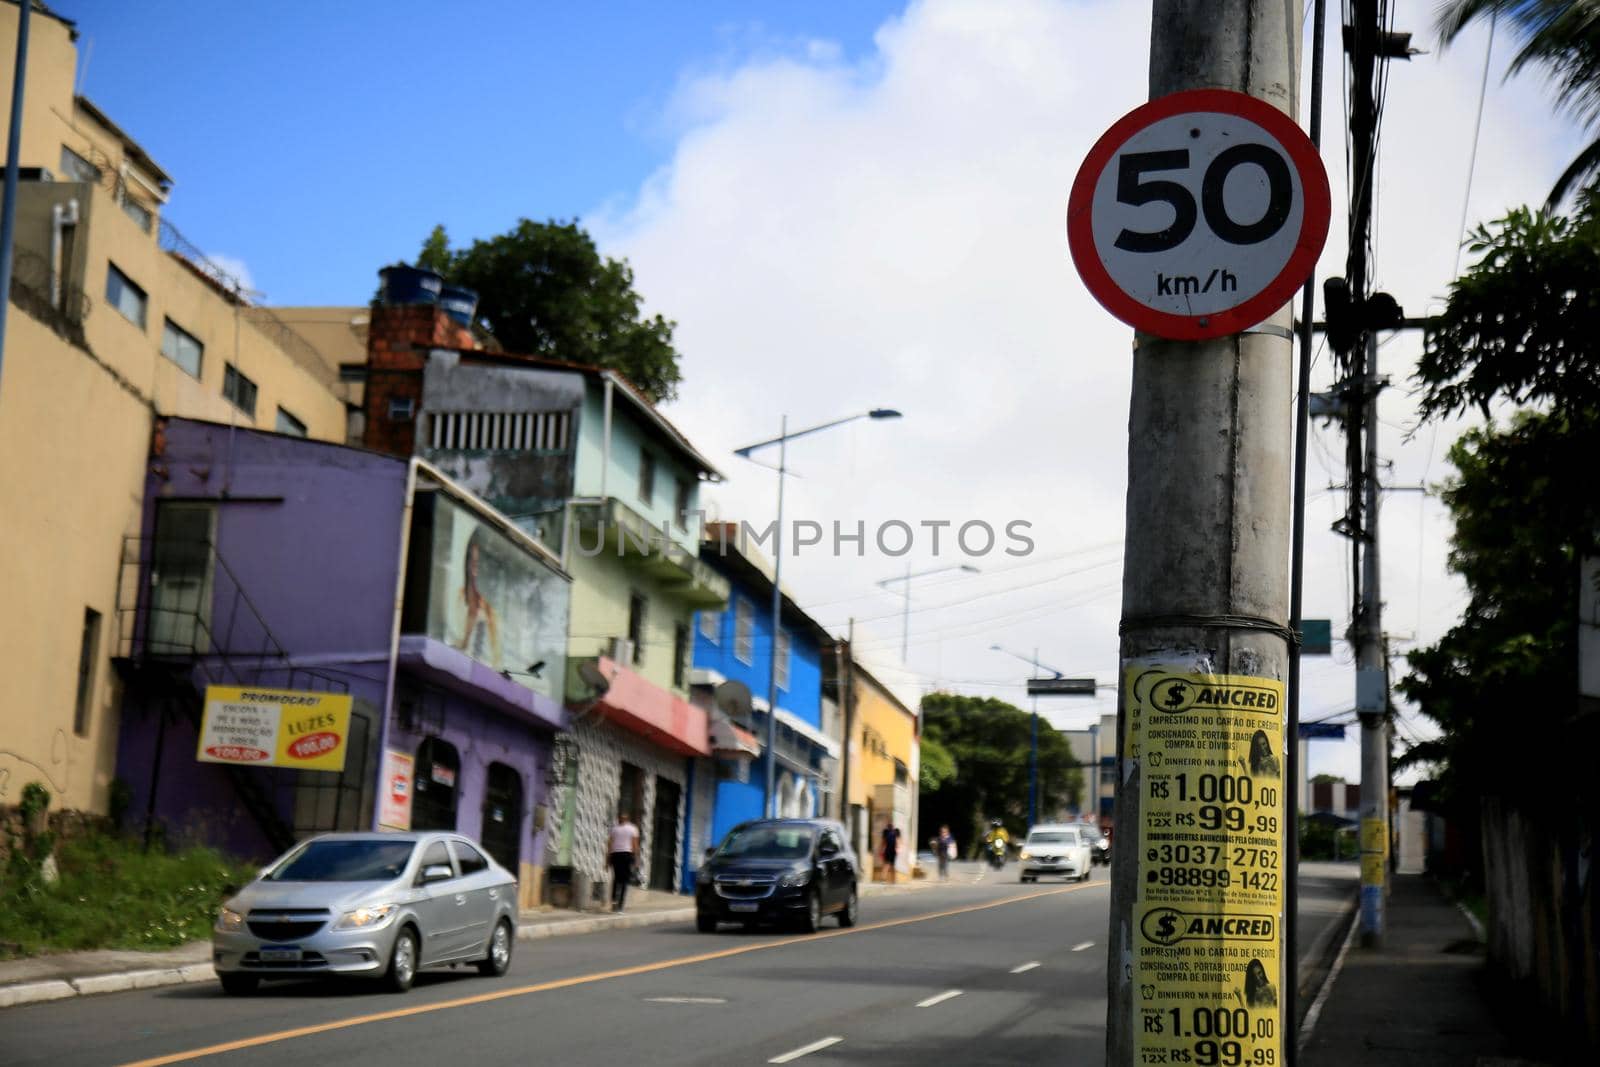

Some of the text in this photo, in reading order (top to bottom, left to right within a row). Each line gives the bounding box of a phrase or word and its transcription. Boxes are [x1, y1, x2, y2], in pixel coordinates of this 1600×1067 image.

[1113, 143, 1292, 253] 50
[1157, 269, 1237, 296] km/h
[287, 713, 336, 735] LUZES
[1202, 716, 1213, 726] NO
[1246, 719, 1255, 728] DE
[1165, 740, 1194, 749] COMPRA
[1197, 741, 1206, 749] DE
[1202, 731, 1253, 741] PORTABIDADE
[1164, 758, 1201, 766] DINHEIRO
[1150, 773, 1276, 809] R$ 1.000,00
[1147, 805, 1277, 834] 12X R$ 99,99
[1160, 844, 1277, 869] 3037-2762
[1160, 867, 1277, 891] 98899-1422
[1194, 948, 1206, 957] NO
[1240, 949, 1250, 958] DE
[1156, 972, 1187, 981] COMPRA
[1190, 973, 1199, 981] DE
[1157, 991, 1195, 999] DINHEIRO
[1212, 992, 1234, 1000] HORA!
[1144, 1007, 1273, 1043] R$ 1.000,00
[1141, 1040, 1275, 1067] 12X R$ 99,99
